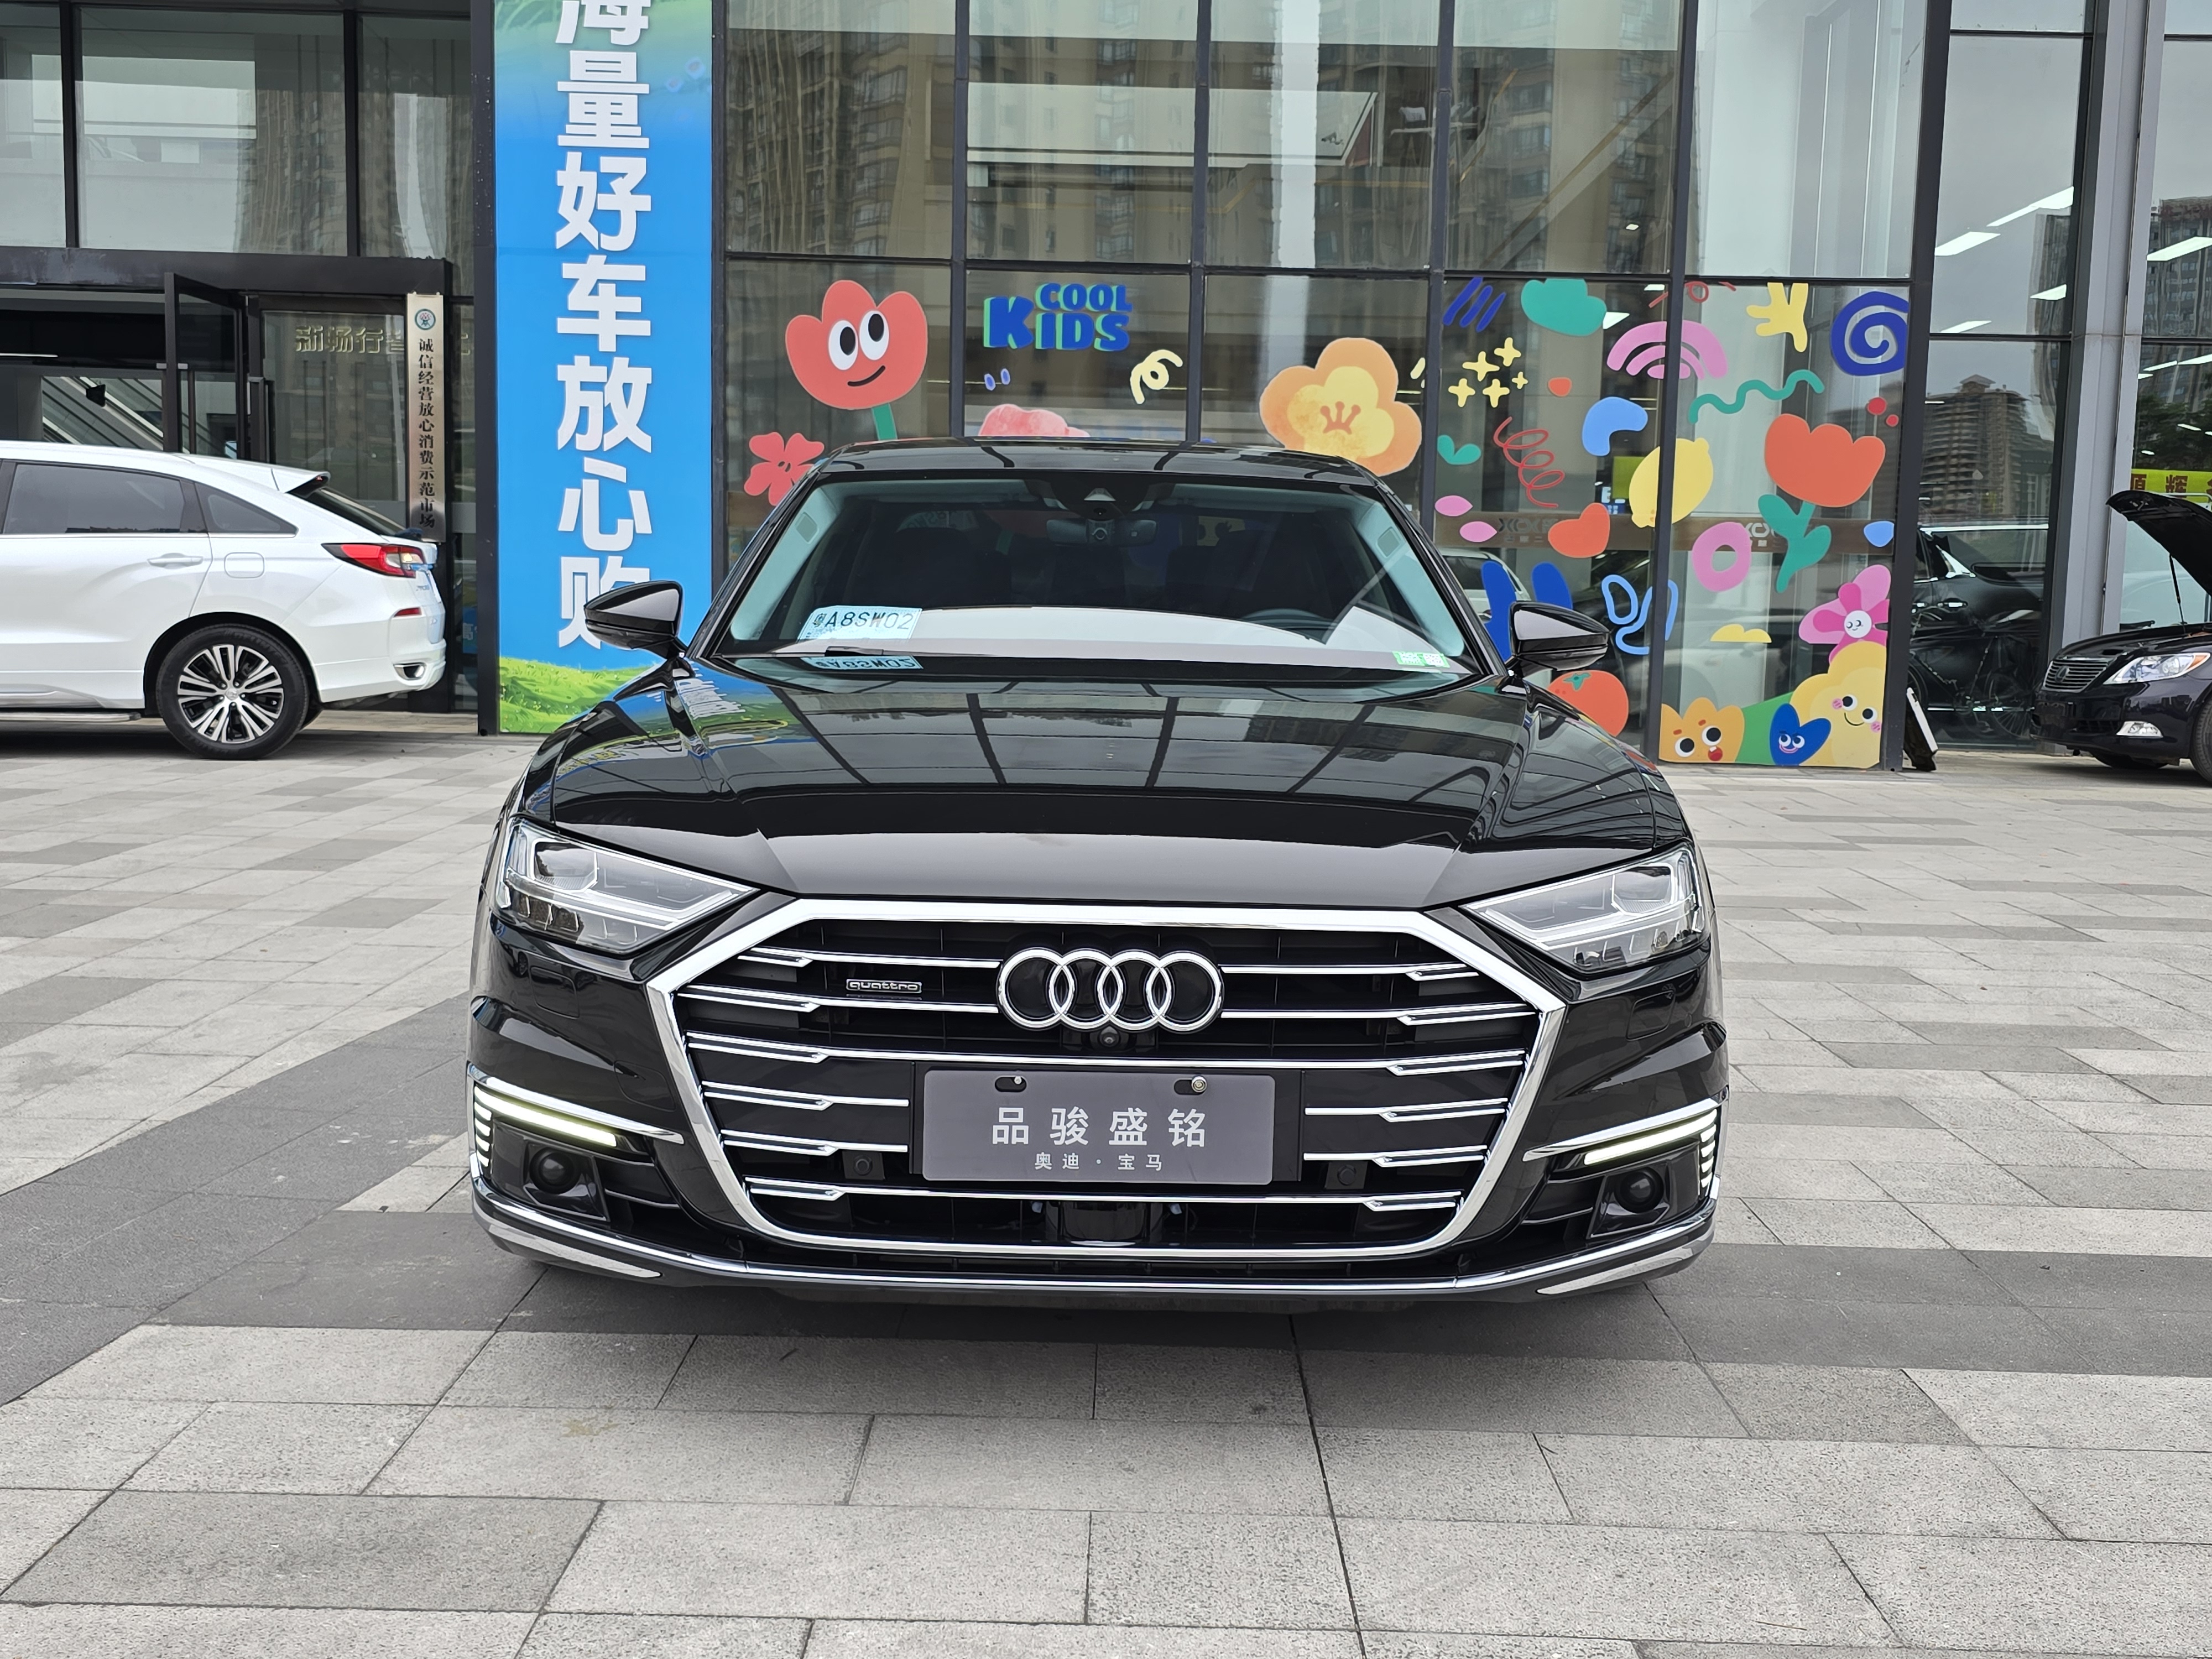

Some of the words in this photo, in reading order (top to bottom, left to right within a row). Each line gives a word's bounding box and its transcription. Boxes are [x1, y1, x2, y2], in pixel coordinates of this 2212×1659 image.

[1035, 283, 1133, 312] COOL
[983, 296, 1130, 352] KIDS
[418, 338, 435, 529] 诚信经营放心消费示范市场
[849, 981, 919, 991] quattro
[993, 1107, 1206, 1147] 品骏盛铭
